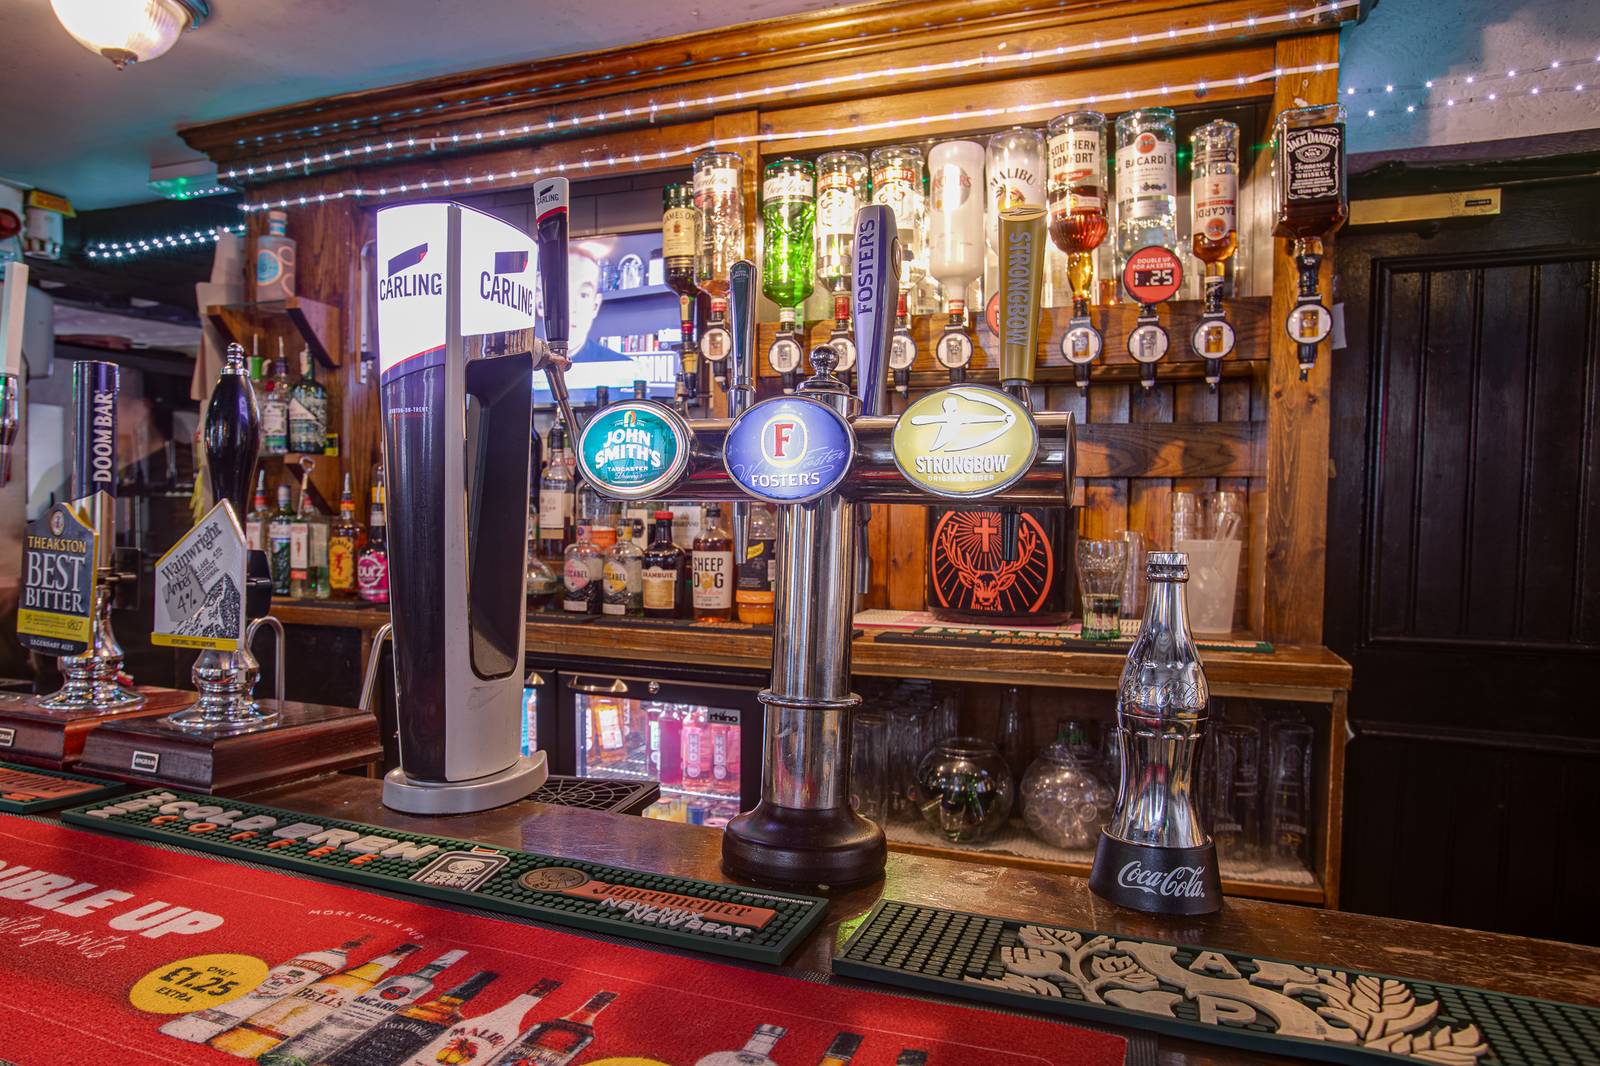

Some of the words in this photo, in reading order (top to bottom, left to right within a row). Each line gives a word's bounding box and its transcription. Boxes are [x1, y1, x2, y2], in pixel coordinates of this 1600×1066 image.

[1287, 136, 1307, 152] JACK
[1307, 132, 1341, 148] DANIEL'S
[537, 194, 560, 206] CARLING
[857, 219, 875, 315] FOSTER'S
[379, 273, 443, 301] CARLING
[480, 271, 533, 316] CARLING
[1007, 231, 1032, 346] STRONGBOW
[603, 428, 650, 449] JOHN
[774, 423, 795, 457] F
[595, 444, 661, 469] SMITH'S
[915, 455, 1009, 474] STRONGBOW
[751, 472, 821, 488] FOSTER'S
[28, 535, 87, 553] THEAKSTON
[161, 522, 222, 580] Wainwright
[26, 551, 86, 592] BEST
[694, 557, 724, 572] SHEEP
[25, 587, 85, 613] BITTER
[710, 711, 738, 722] rhino
[151, 815, 380, 865] COFFEE
[159, 801, 277, 831] COLD
[272, 822, 440, 862] BREW
[1118, 860, 1205, 898] Coca-Cola
[108, 900, 225, 939] UP
[601, 896, 654, 915] NEW
[655, 906, 705, 922] MIX
[624, 907, 685, 927] NEW
[684, 919, 752, 938] BEAT
[308, 908, 355, 918] MORE
[357, 912, 394, 926] THAN
[403, 927, 425, 941] PUB
[158, 966, 240, 997] £1.25
[207, 965, 238, 978] ONLY
[155, 985, 194, 1002] EXTRA
[295, 987, 347, 1010] BELL'S
